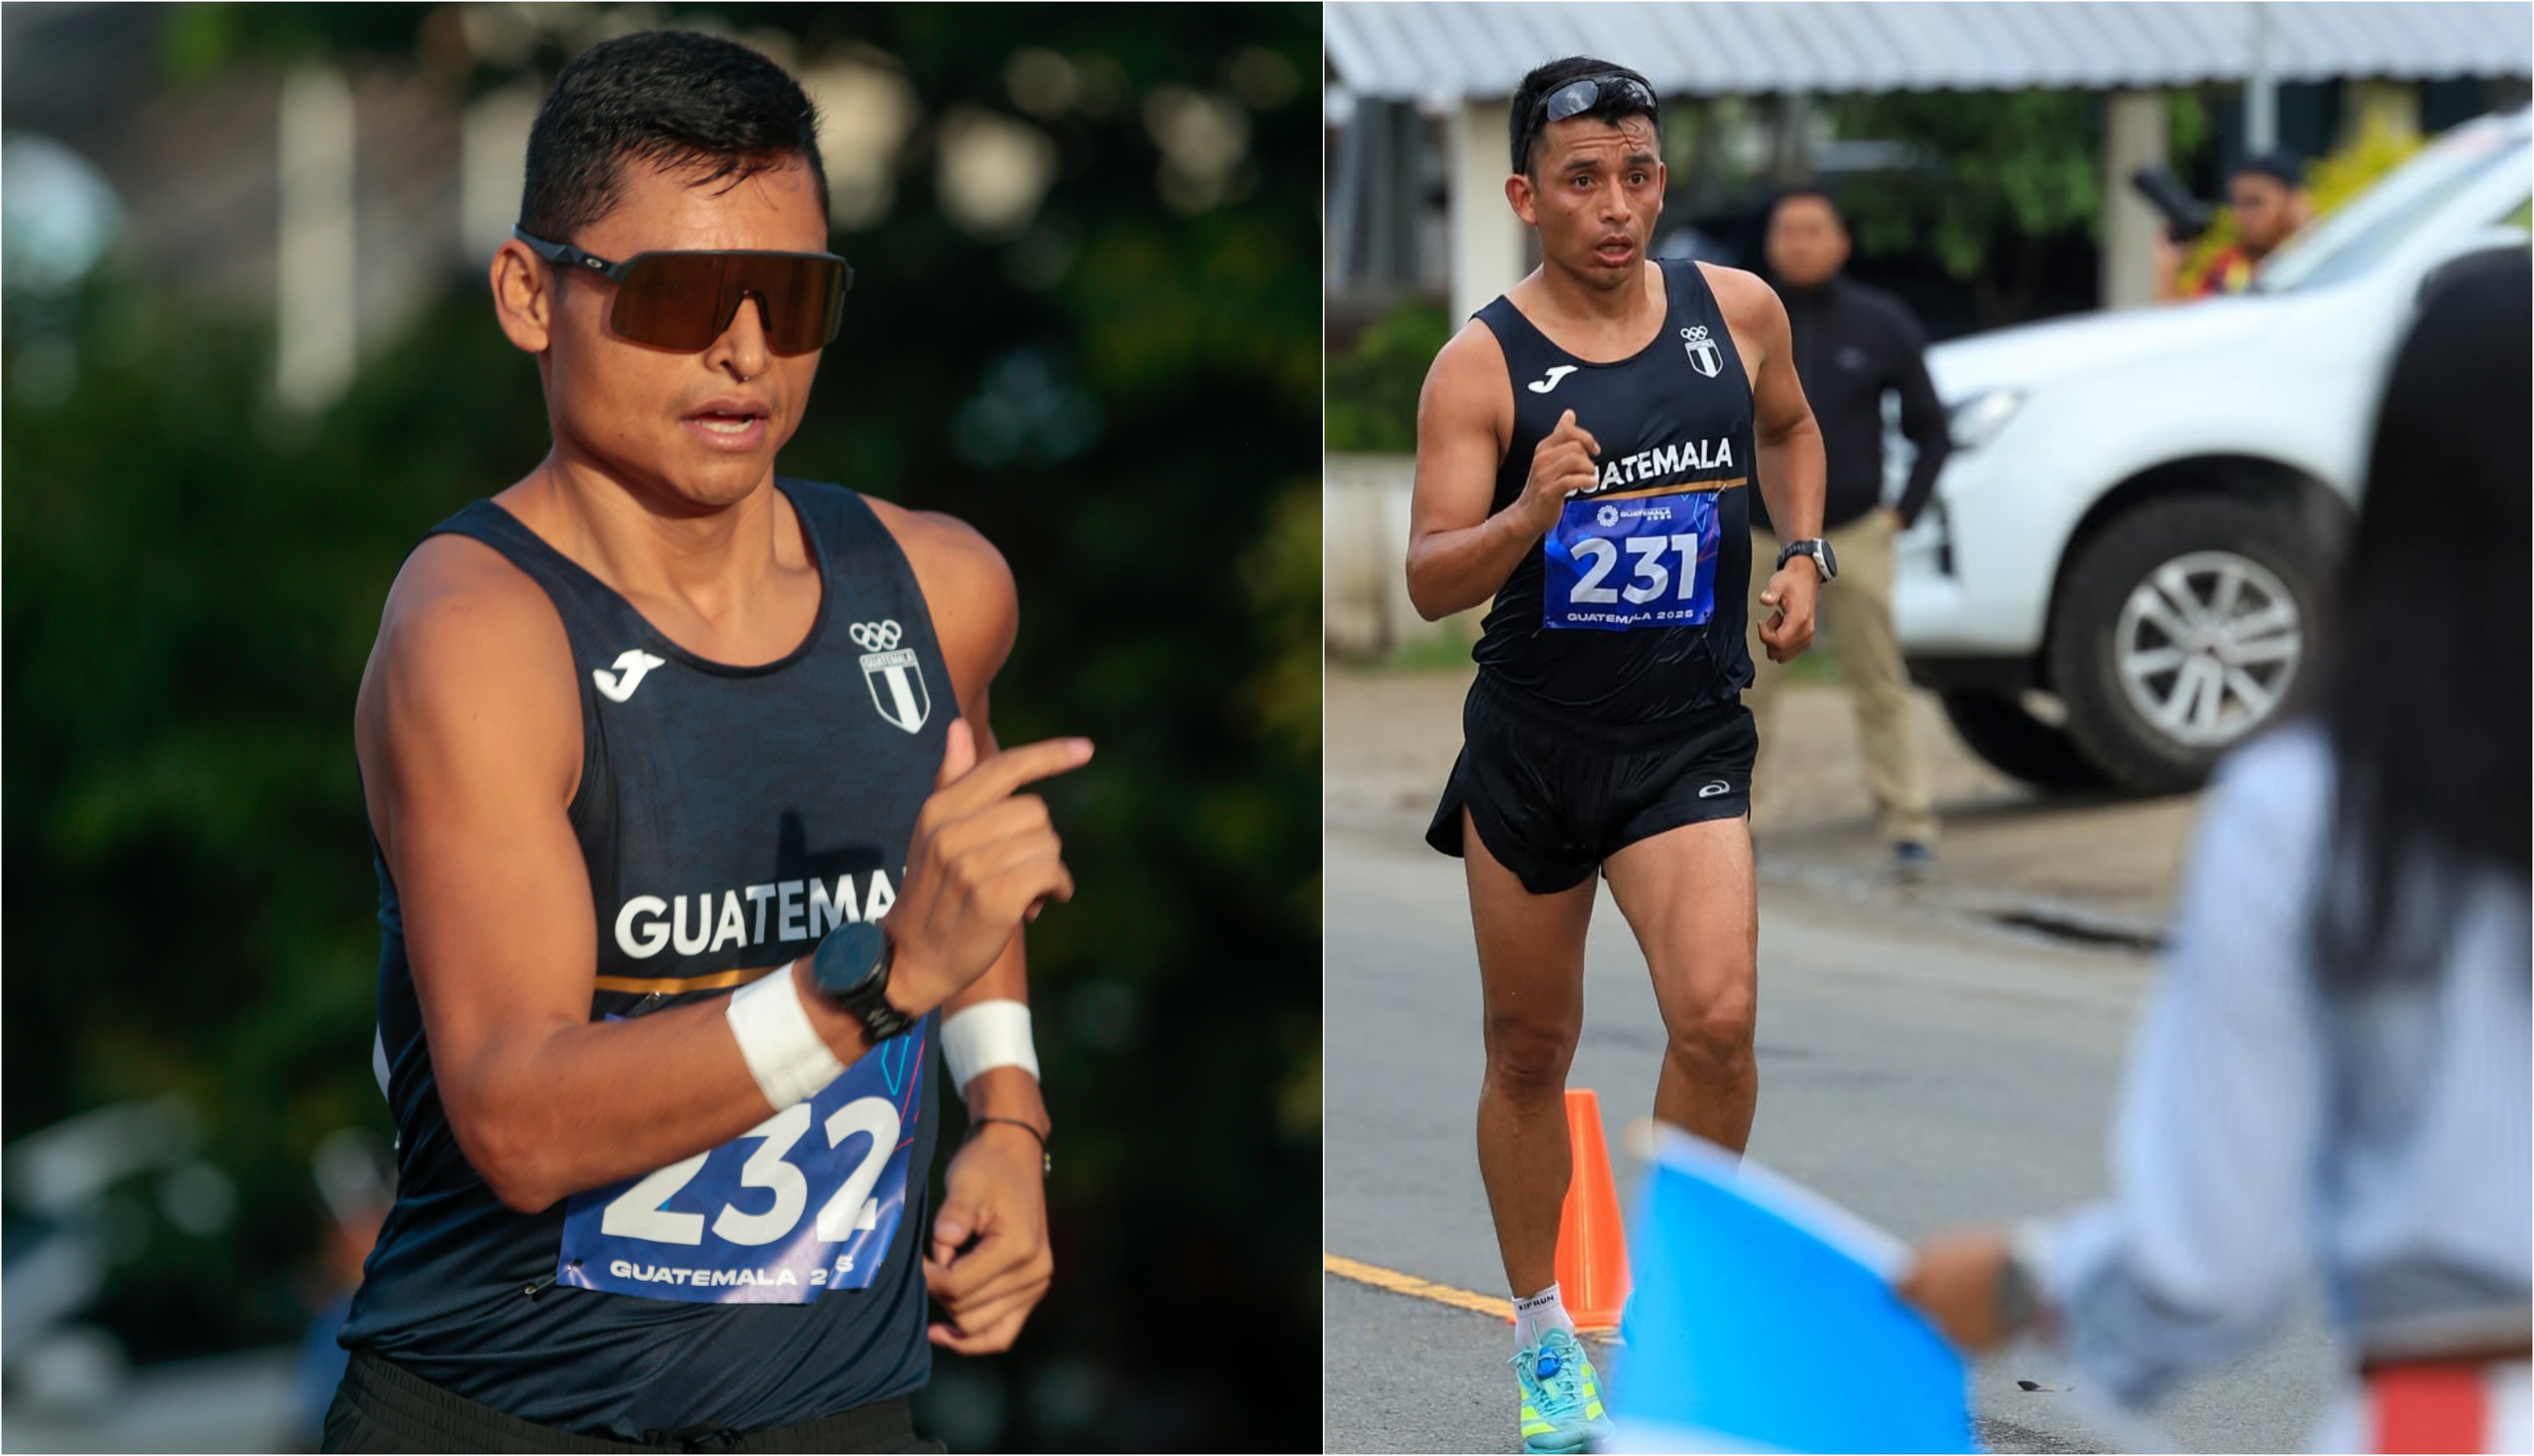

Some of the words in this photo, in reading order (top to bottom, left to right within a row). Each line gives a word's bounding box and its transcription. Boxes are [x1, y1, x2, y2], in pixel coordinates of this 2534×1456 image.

[1564, 437, 1734, 497] UATEMALA
[1570, 532, 1698, 605] 231
[1656, 609, 1694, 619] 2025
[615, 865, 908, 959] GUATEMA
[601, 1096, 901, 1246] 232
[610, 1260, 798, 1287] GUATEMALA
[810, 1254, 854, 1286] 25
